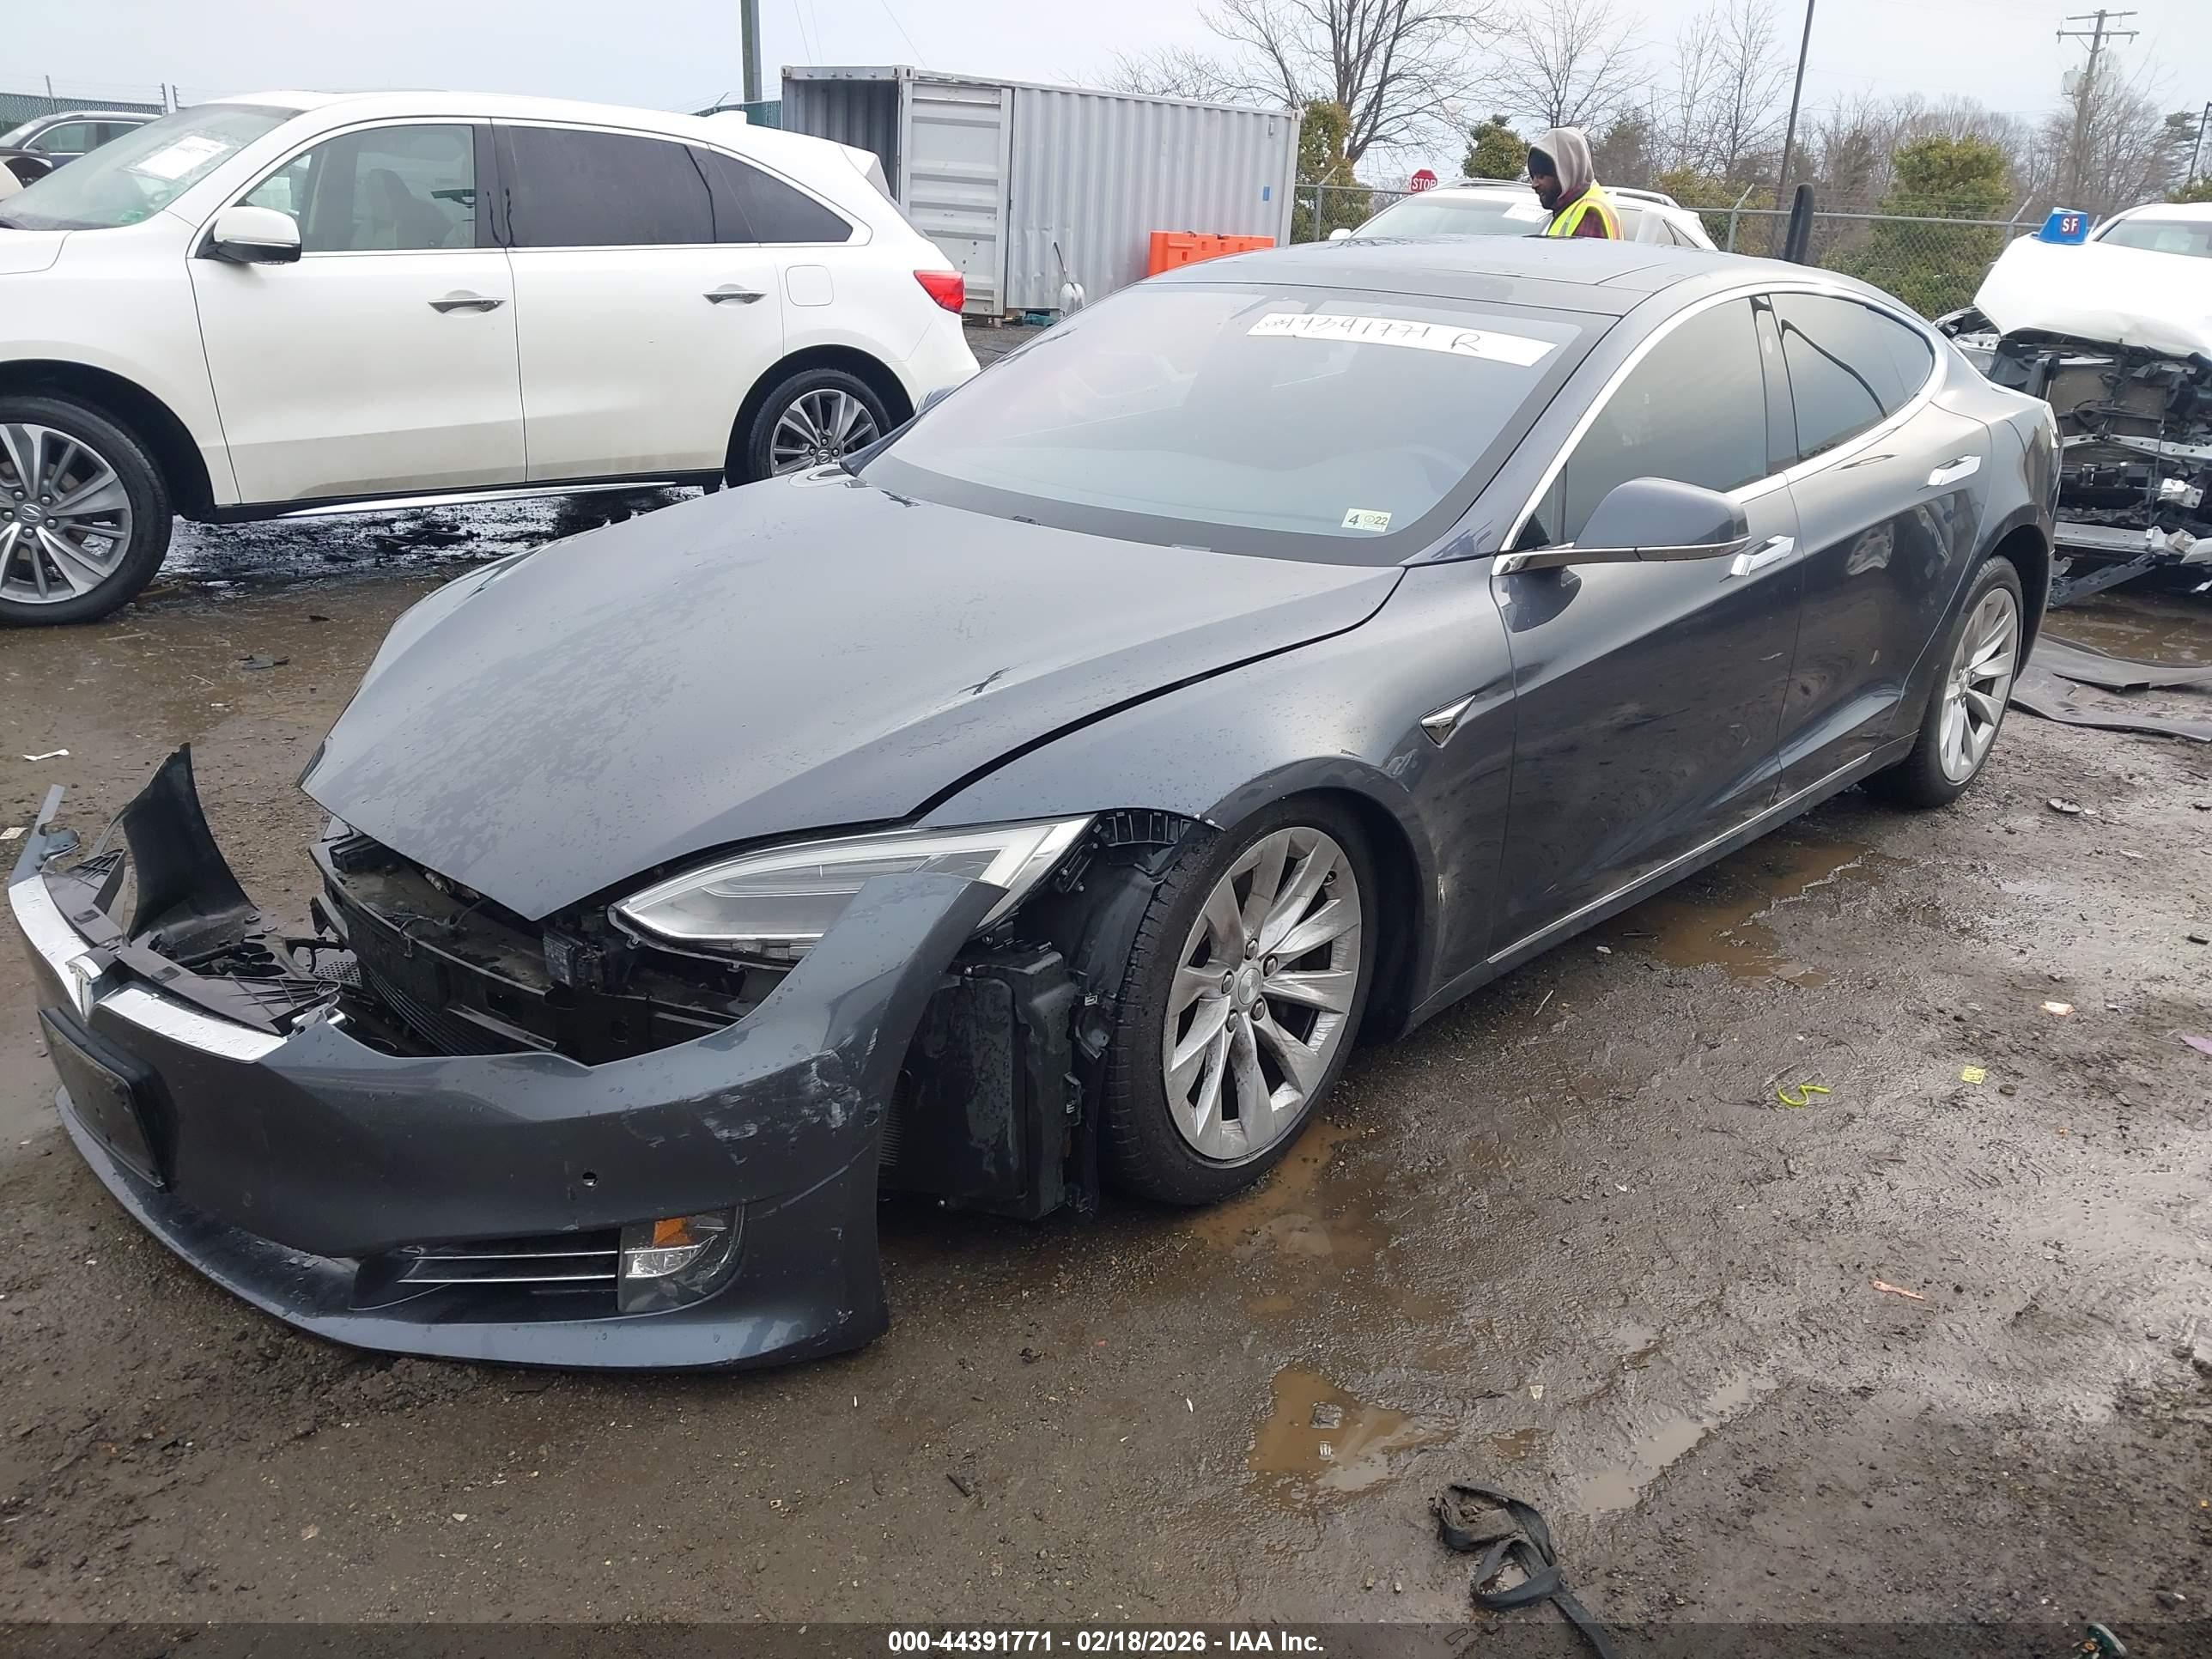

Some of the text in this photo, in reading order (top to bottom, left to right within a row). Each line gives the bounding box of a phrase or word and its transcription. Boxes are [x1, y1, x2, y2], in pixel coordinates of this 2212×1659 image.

[1412, 177, 1437, 191] STOP
[2062, 217, 2079, 232] SF
[1450, 332, 1481, 352] R
[1347, 514, 1360, 526] 4
